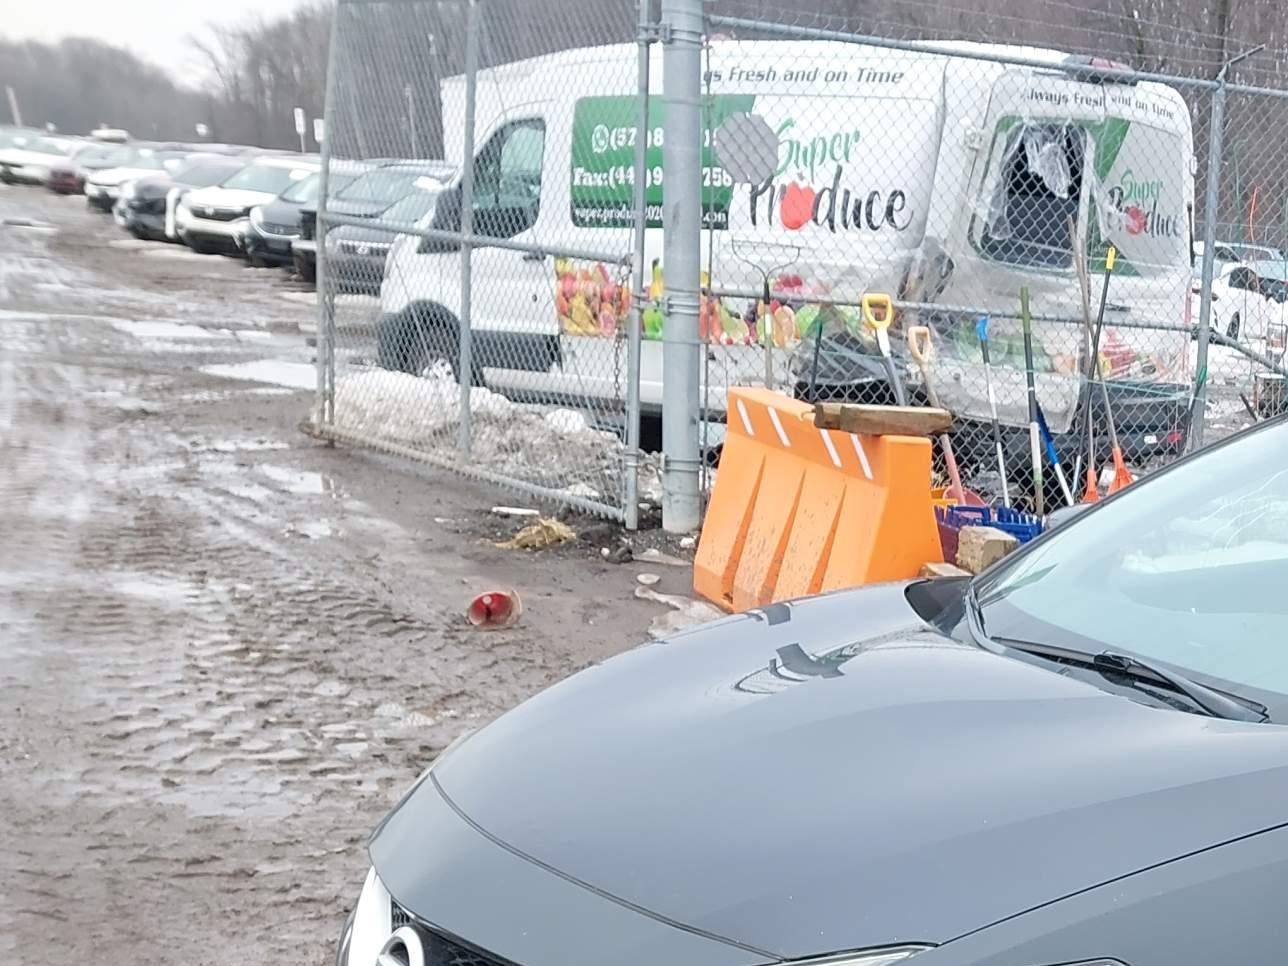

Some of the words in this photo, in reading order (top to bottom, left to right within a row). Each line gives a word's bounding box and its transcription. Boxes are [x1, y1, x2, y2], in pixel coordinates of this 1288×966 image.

[728, 65, 777, 83] Fresh
[783, 67, 819, 83] and
[824, 70, 849, 83] on
[857, 67, 904, 84] Time
